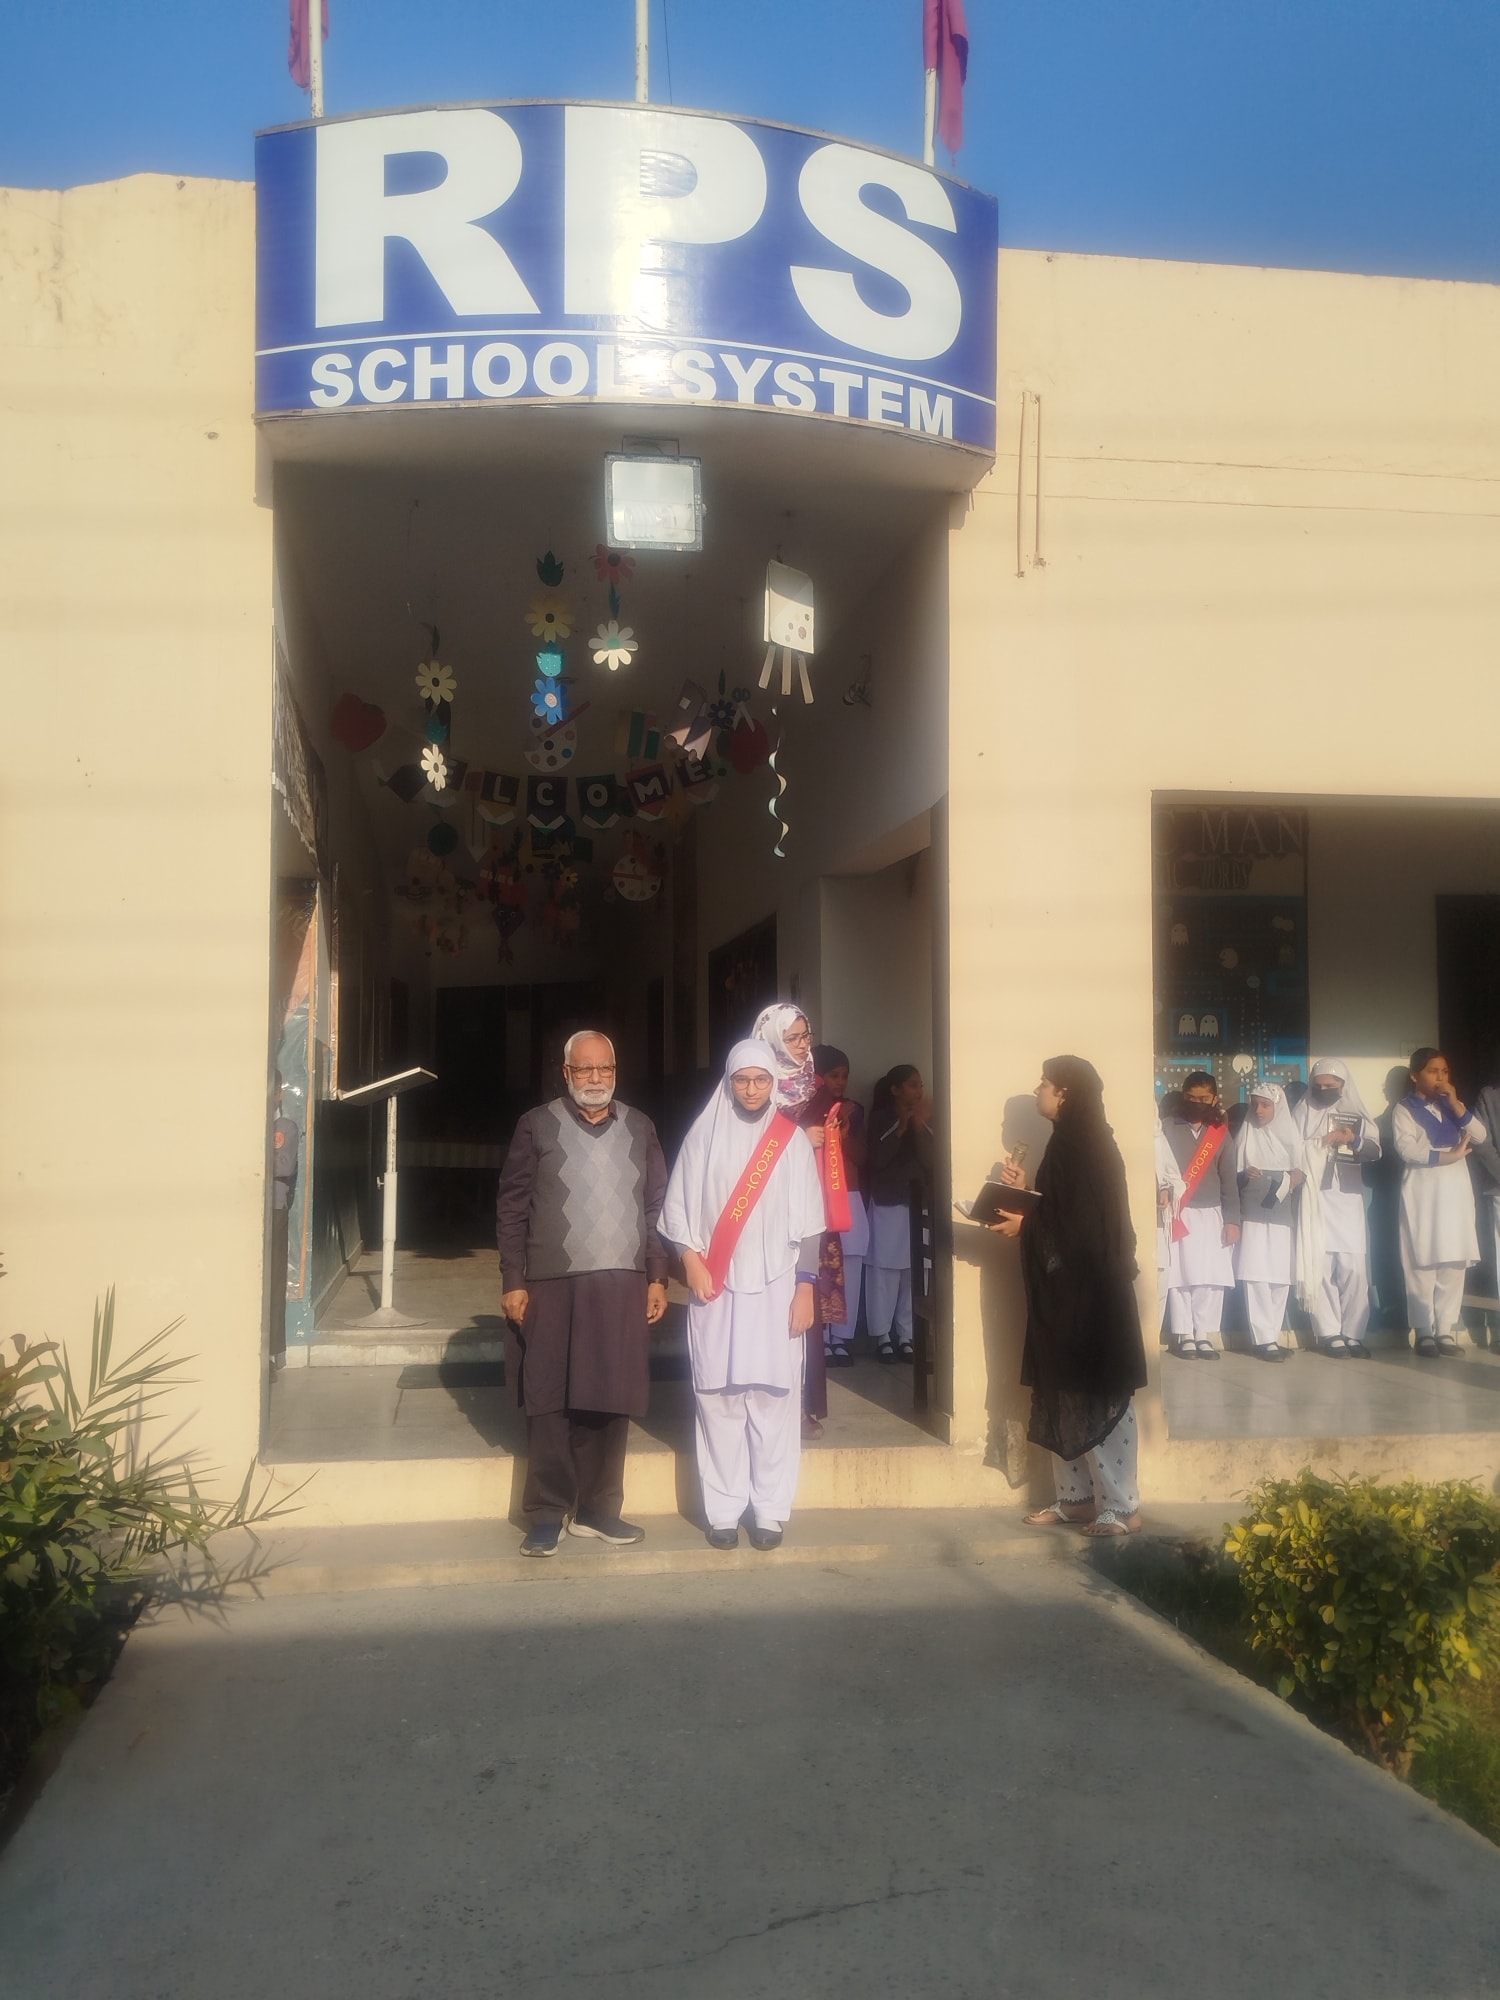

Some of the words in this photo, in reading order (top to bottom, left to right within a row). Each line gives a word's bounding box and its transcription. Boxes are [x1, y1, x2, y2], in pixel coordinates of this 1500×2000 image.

[315, 105, 962, 361] RPS
[309, 342, 641, 408] SCHOOL
[670, 349, 954, 439] SYSTEM
[1199, 807, 1303, 854] MAN
[729, 1139, 779, 1223] PROCTOR
